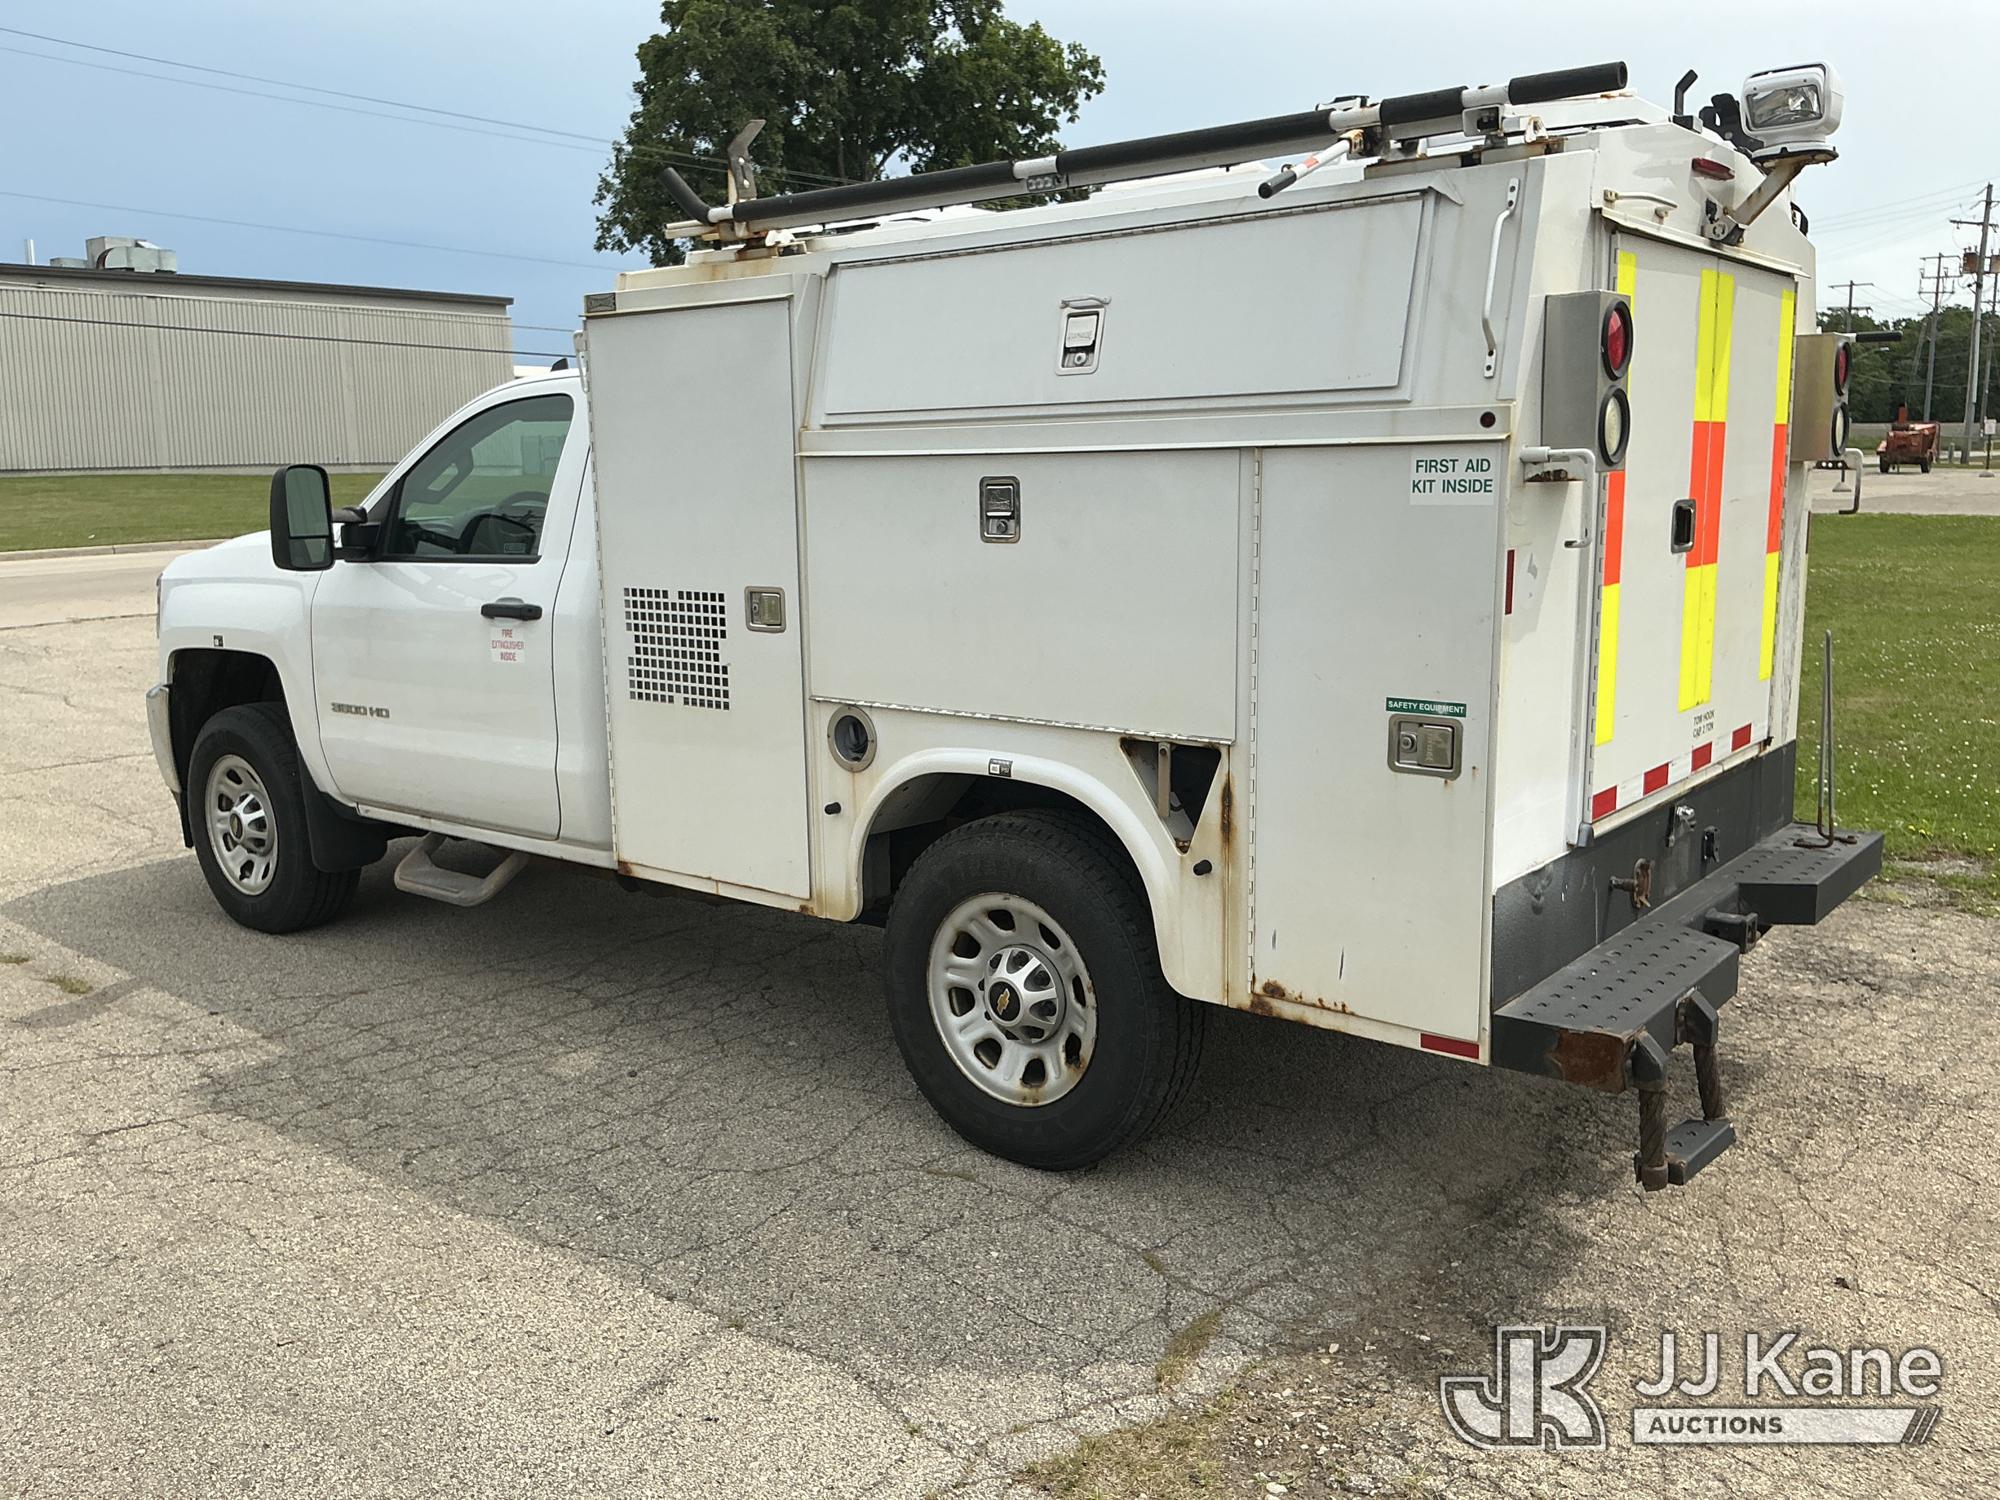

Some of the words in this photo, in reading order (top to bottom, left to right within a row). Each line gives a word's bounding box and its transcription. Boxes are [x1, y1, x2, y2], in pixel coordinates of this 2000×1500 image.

[1415, 459, 1459, 473] FIRST
[1465, 458, 1491, 473] AID
[1412, 479, 1436, 493] KIT
[1442, 479, 1493, 493] INSIDE
[1388, 700, 1417, 711] SAFETY
[1419, 703, 1465, 714] EQUIPMENT
